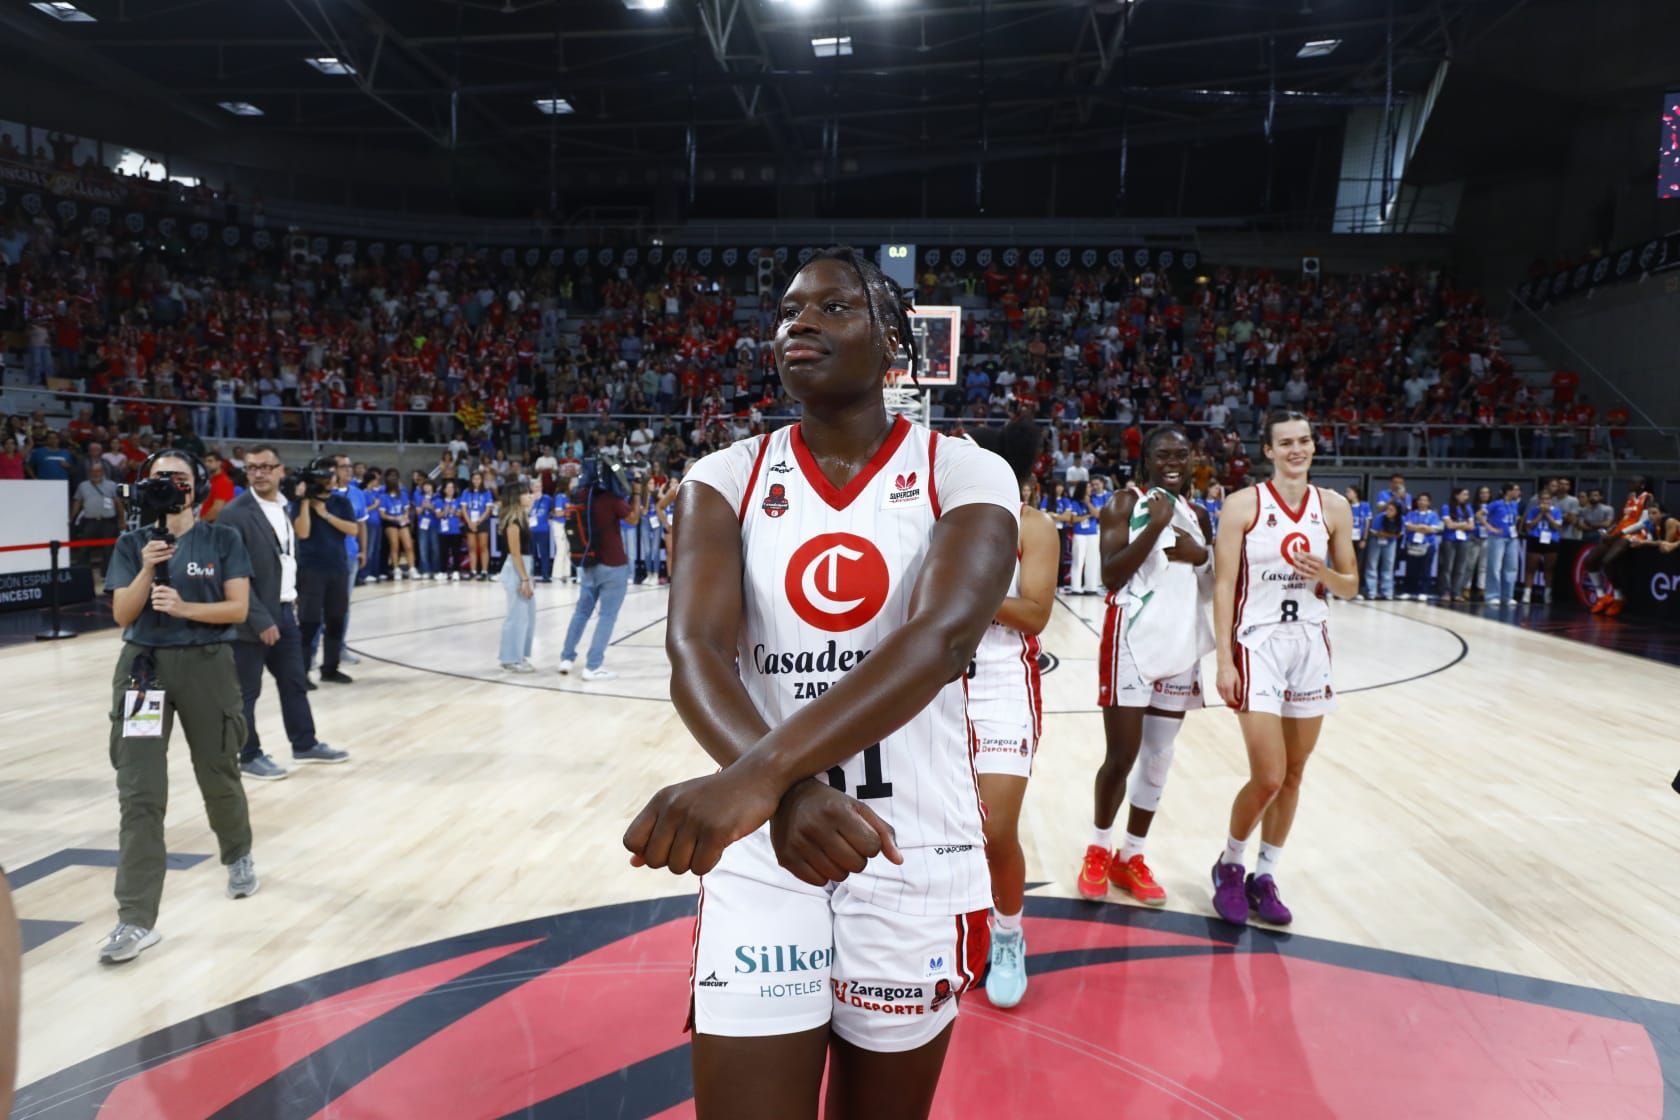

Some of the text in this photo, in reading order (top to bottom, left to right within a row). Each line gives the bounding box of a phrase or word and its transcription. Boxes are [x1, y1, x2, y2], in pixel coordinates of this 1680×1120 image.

[889, 247, 907, 257] 0.0
[890, 489, 920, 499] SUPERCOPA
[1281, 600, 1299, 622] 8
[982, 738, 1018, 746] Zaragoza
[760, 979, 822, 998] HOTELES
[850, 981, 923, 1001] Zaragoza
